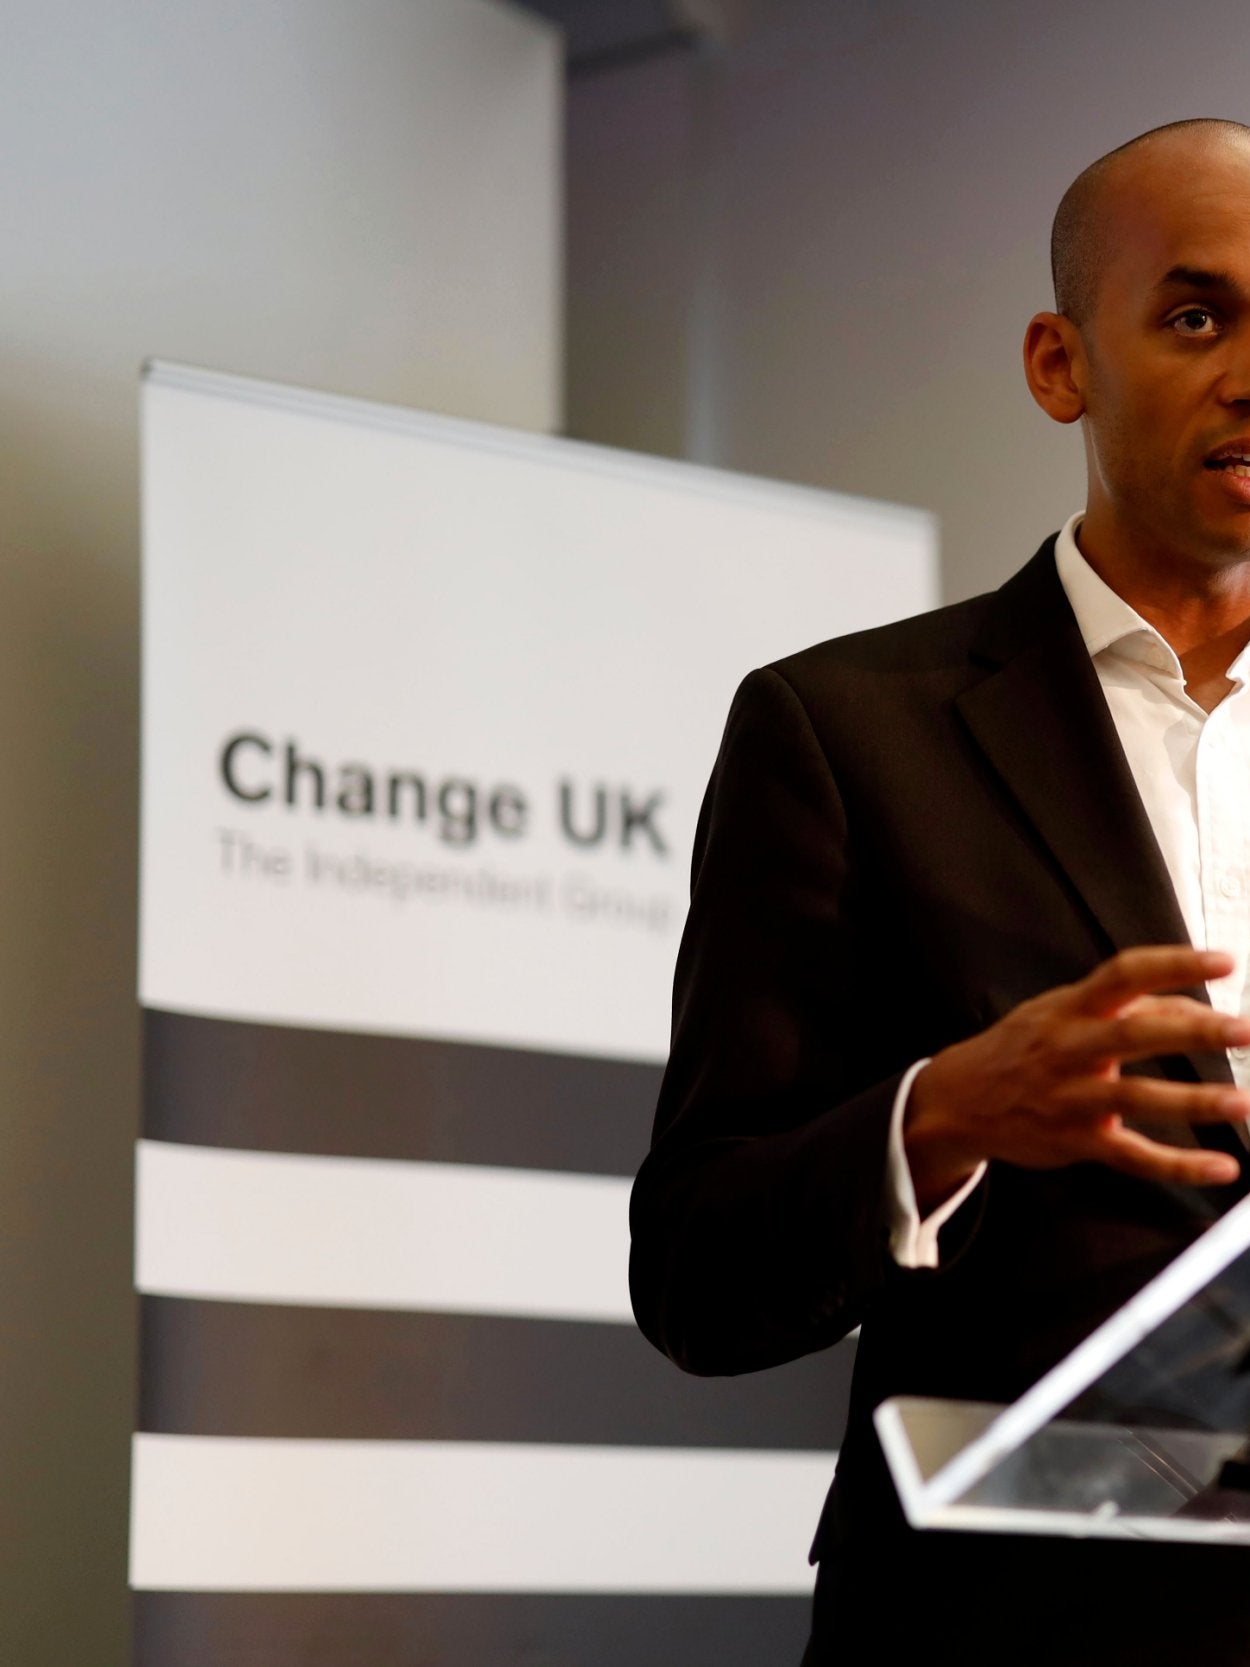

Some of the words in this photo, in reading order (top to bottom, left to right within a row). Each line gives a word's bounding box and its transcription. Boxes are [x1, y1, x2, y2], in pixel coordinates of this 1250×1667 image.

[219, 727, 529, 848] Change
[557, 775, 671, 858] UK
[215, 829, 292, 877] The
[304, 846, 554, 910] Independent
[560, 866, 671, 933] Group
